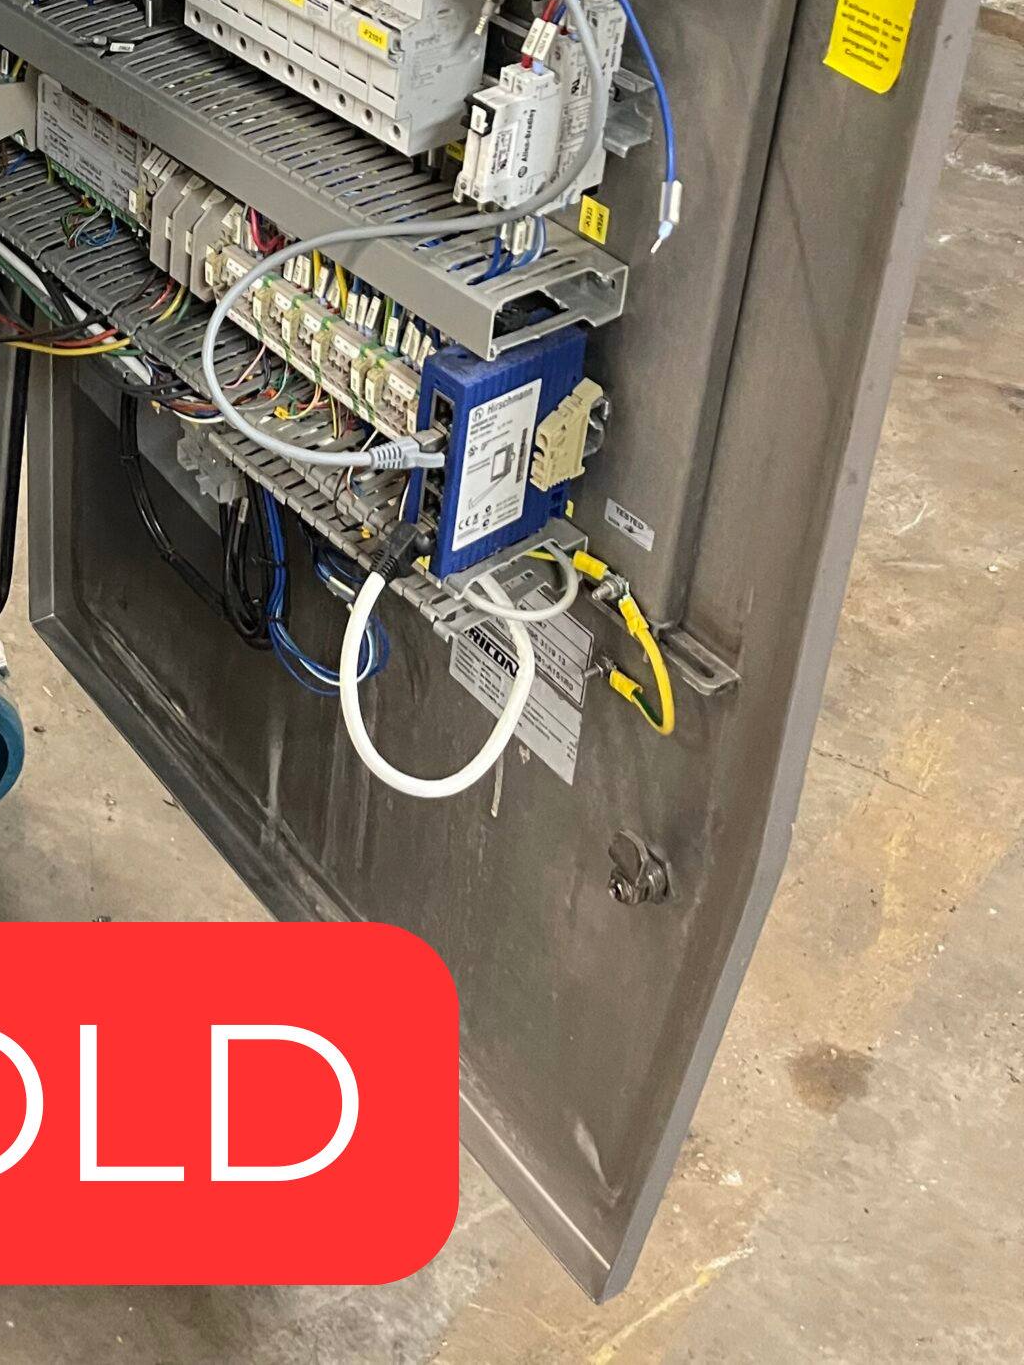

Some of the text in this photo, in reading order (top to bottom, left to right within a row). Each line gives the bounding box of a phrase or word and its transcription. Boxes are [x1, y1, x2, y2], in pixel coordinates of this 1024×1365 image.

[521, 108, 537, 162] Allen-Bradley
[487, 386, 534, 415] Hirschmann
[616, 505, 644, 530] TESTED
[464, 626, 520, 678] RICON
